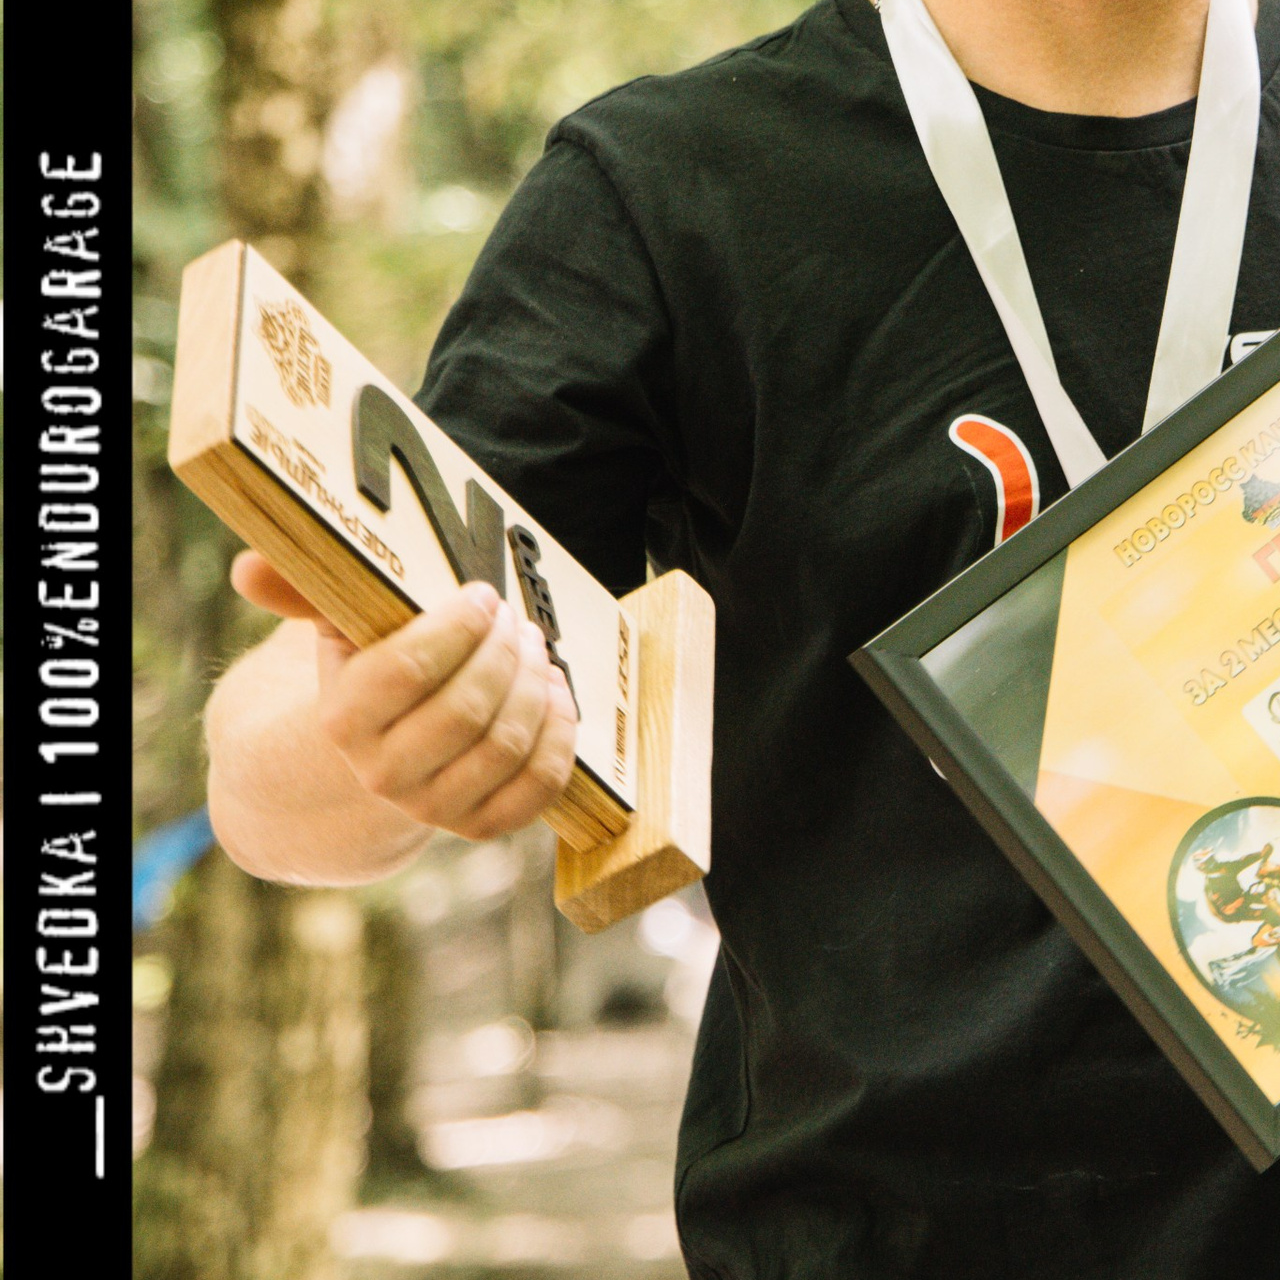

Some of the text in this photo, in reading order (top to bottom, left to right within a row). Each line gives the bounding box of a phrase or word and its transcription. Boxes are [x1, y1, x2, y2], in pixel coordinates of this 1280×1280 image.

[350, 383, 508, 603] 2
[1113, 454, 1249, 568] НОВОРОСС
[1182, 666, 1226, 707] ЗА
[1218, 647, 1248, 675] 2
